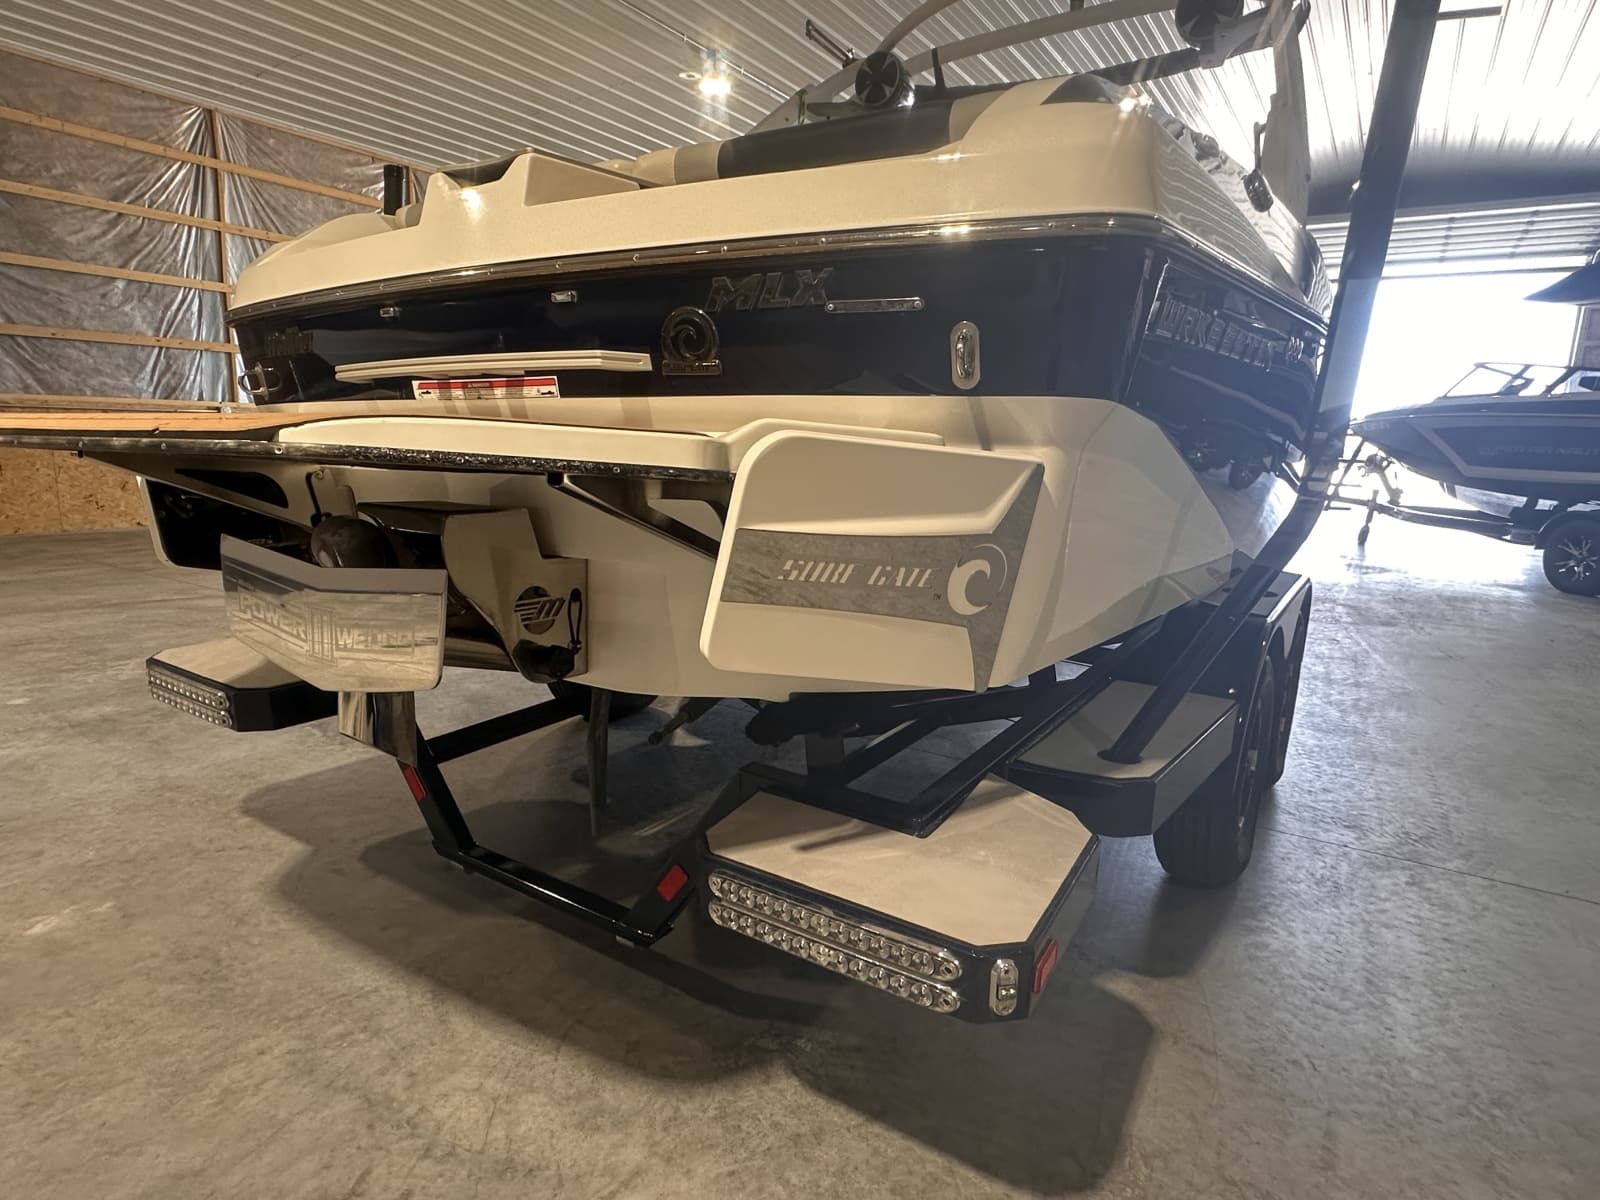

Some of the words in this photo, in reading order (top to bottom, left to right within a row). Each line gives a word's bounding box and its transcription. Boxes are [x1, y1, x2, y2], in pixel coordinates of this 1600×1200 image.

[706, 268, 835, 312] MLX
[778, 559, 861, 584] SURF
[867, 564, 940, 588] GATE
[238, 595, 307, 638] POWER
